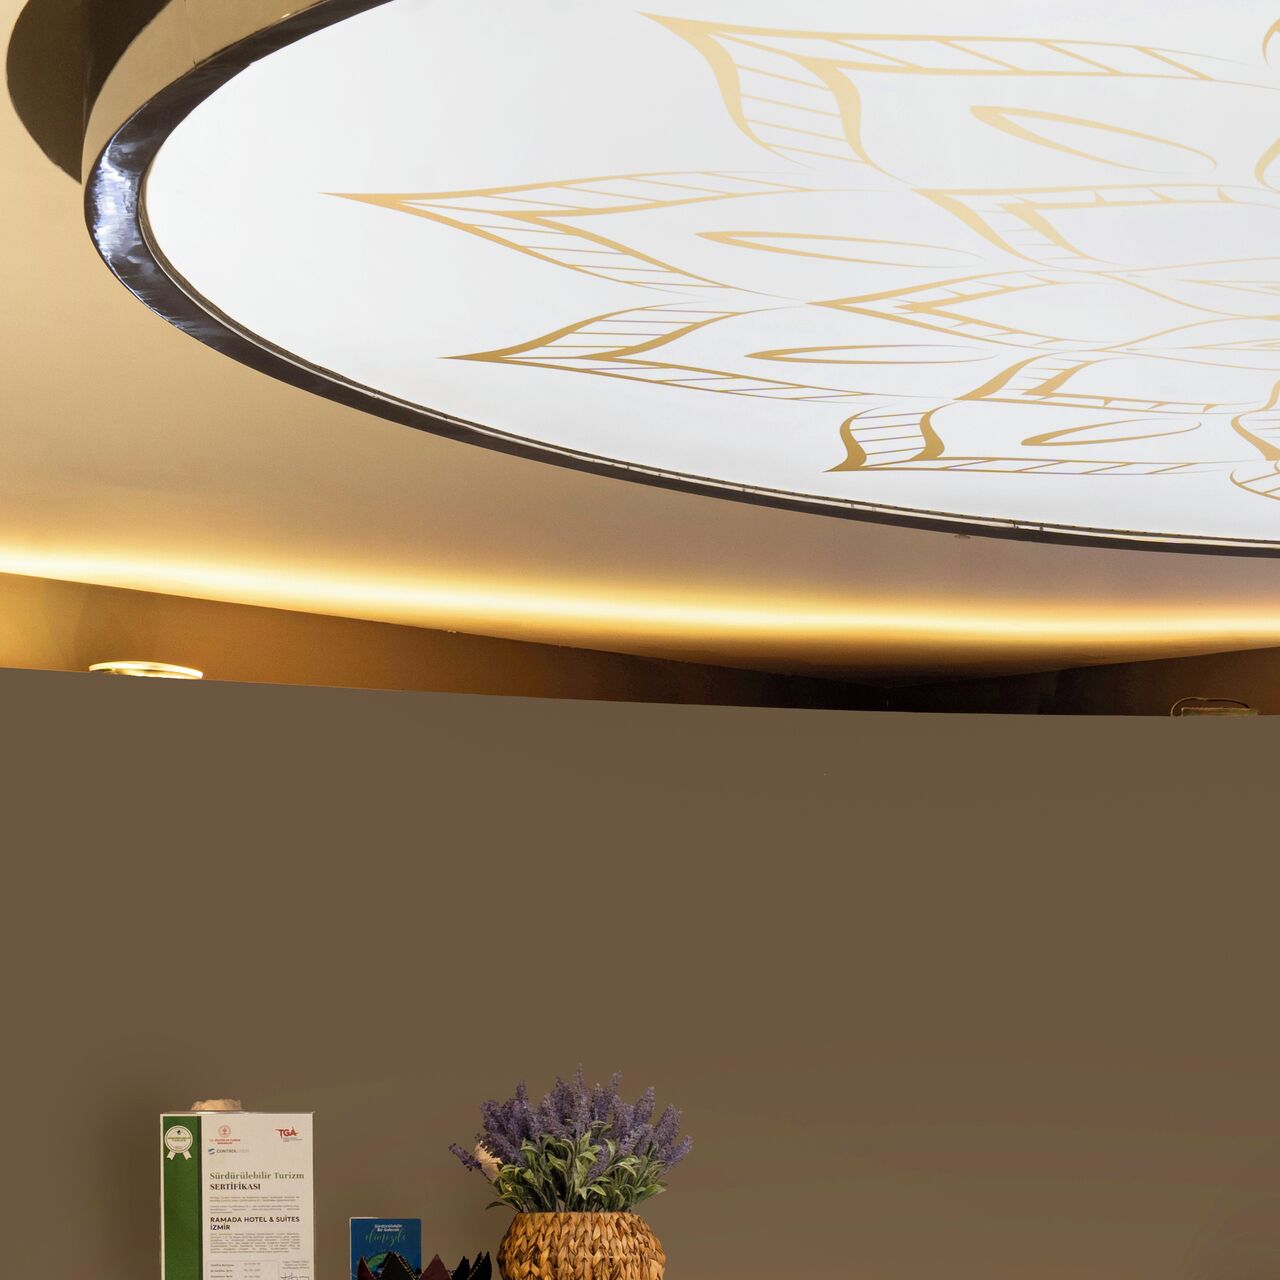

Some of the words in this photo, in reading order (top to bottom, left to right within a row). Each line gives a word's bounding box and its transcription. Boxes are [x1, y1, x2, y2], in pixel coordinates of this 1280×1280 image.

[275, 1126, 298, 1138] TGA
[210, 1171, 272, 1180] Sürdürülebilir
[274, 1171, 305, 1180] Turizm
[210, 1181, 261, 1190] SERTİFİKASI
[210, 1223, 231, 1231] İZMİR
